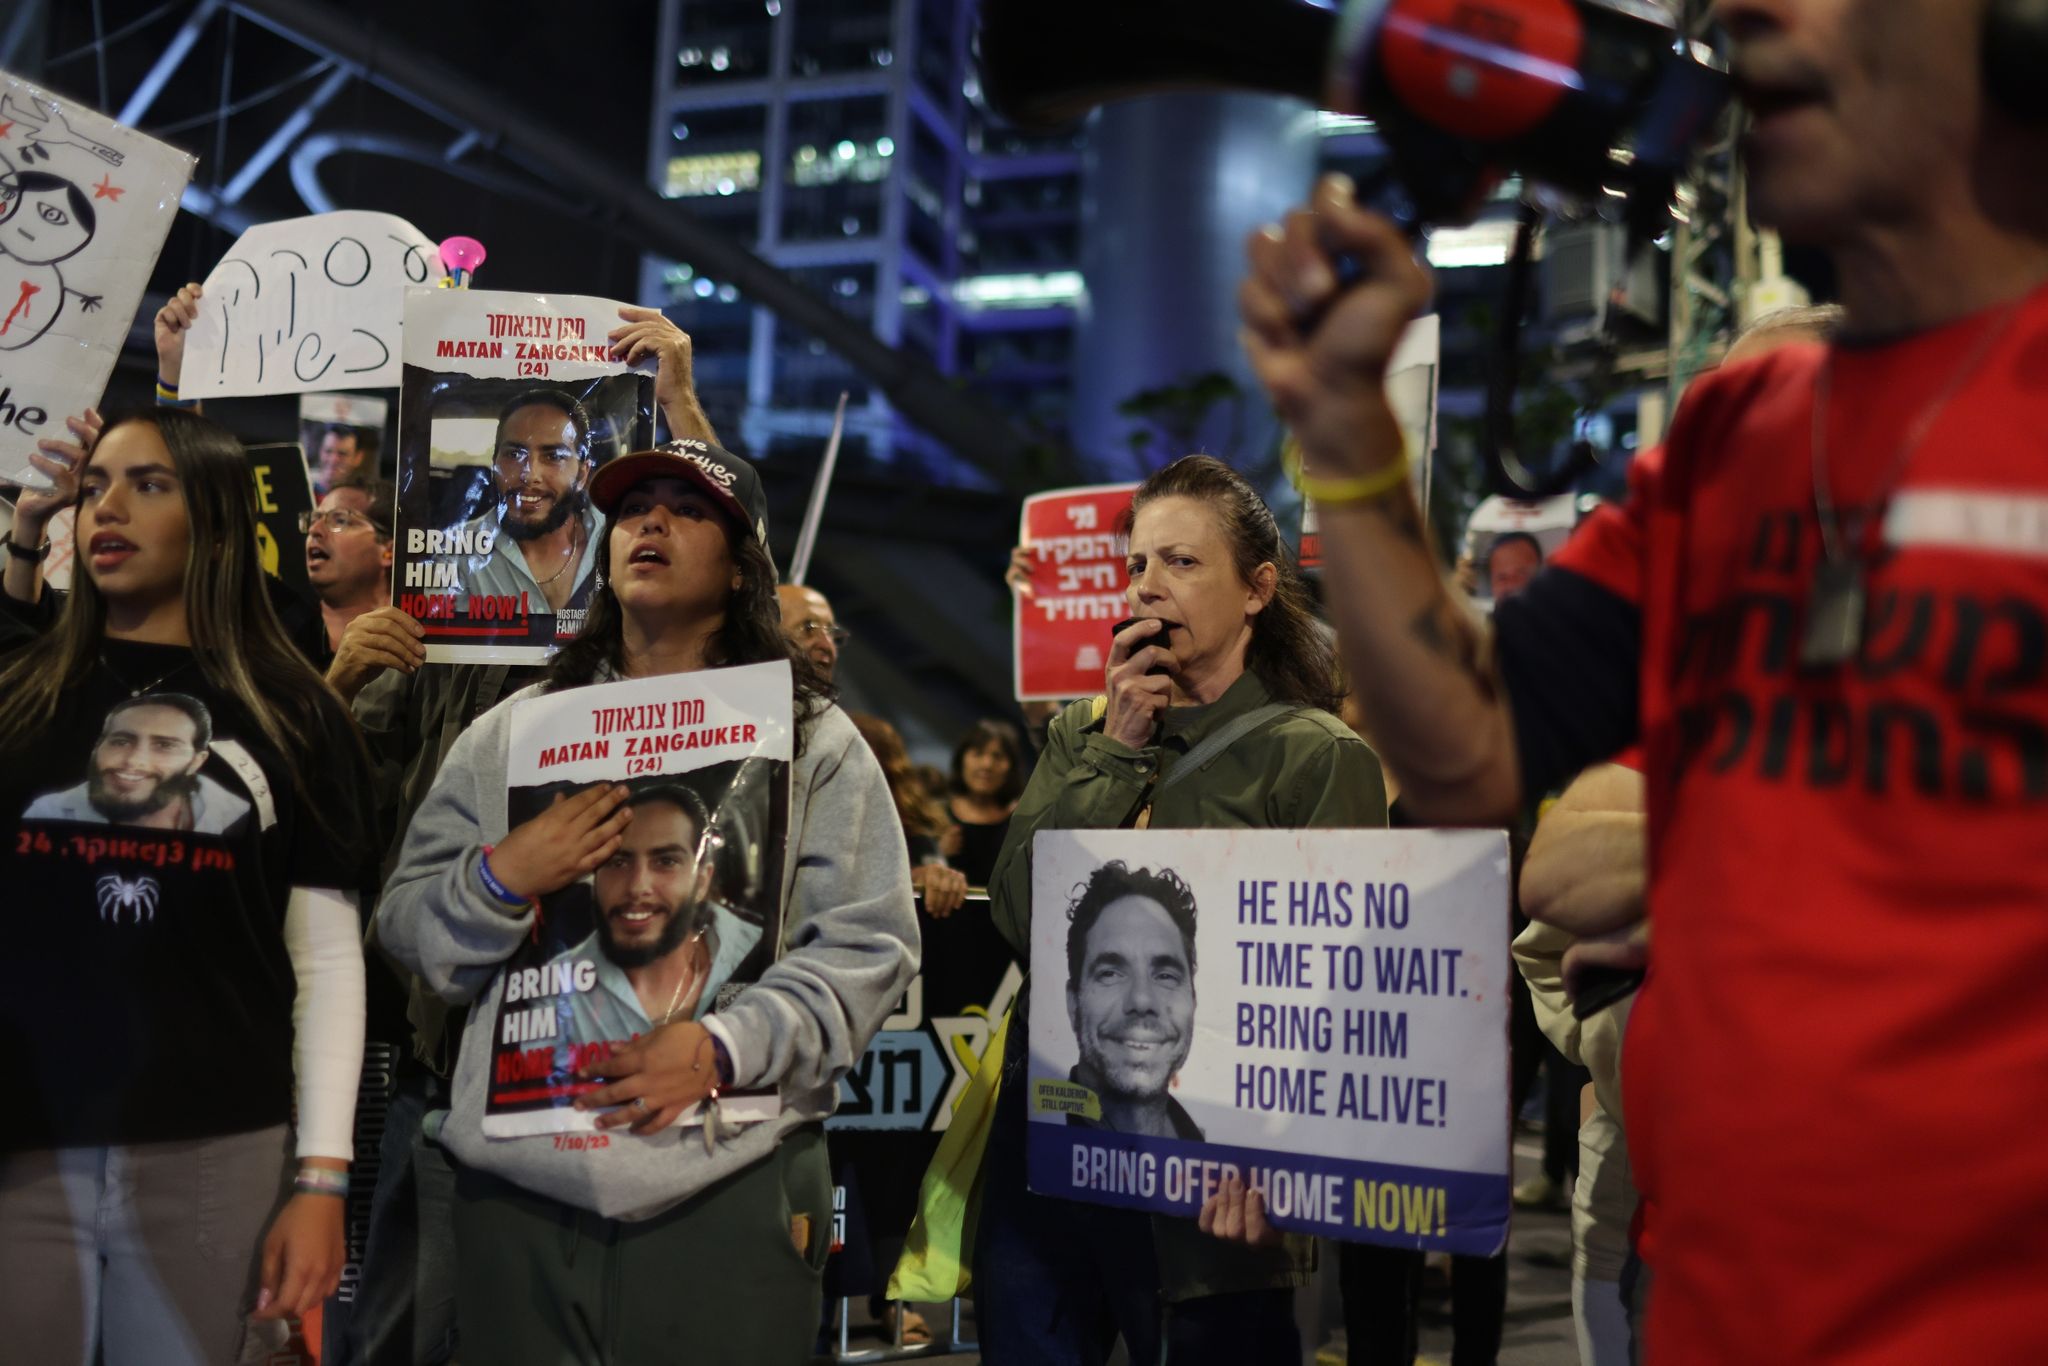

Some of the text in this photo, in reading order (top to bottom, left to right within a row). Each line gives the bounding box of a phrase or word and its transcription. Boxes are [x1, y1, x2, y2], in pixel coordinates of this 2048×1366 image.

[218, 301, 403, 385] כשיו!
[487, 314, 586, 341] מתן צנגאוקר
[436, 340, 628, 363] MATAN ZANGAUKE
[518, 362, 549, 377] (24)
[1066, 504, 1097, 530] מי
[407, 528, 494, 555] BRING
[405, 561, 459, 588] HIM
[1056, 564, 1118, 591] חייב
[400, 593, 456, 619] HOME
[592, 698, 705, 736] מתן צנגאוקר
[538, 724, 757, 768] MATAN ZANGAUKER
[626, 756, 662, 775] (24)
[1238, 880, 1409, 930] HE HAS NO
[505, 959, 597, 1003] BRING
[1236, 941, 1468, 997] TIME TO WAIT.
[502, 1006, 558, 1045] HIM
[1236, 1002, 1408, 1059] BRING HIM
[496, 1046, 555, 1084] HOME
[1235, 1063, 1446, 1128] HOME ALIVE!
[553, 1135, 610, 1151] 7/10/23
[1072, 1143, 1156, 1198] BRING
[1250, 1166, 1344, 1225] HOME
[1353, 1178, 1446, 1237] NOW!
